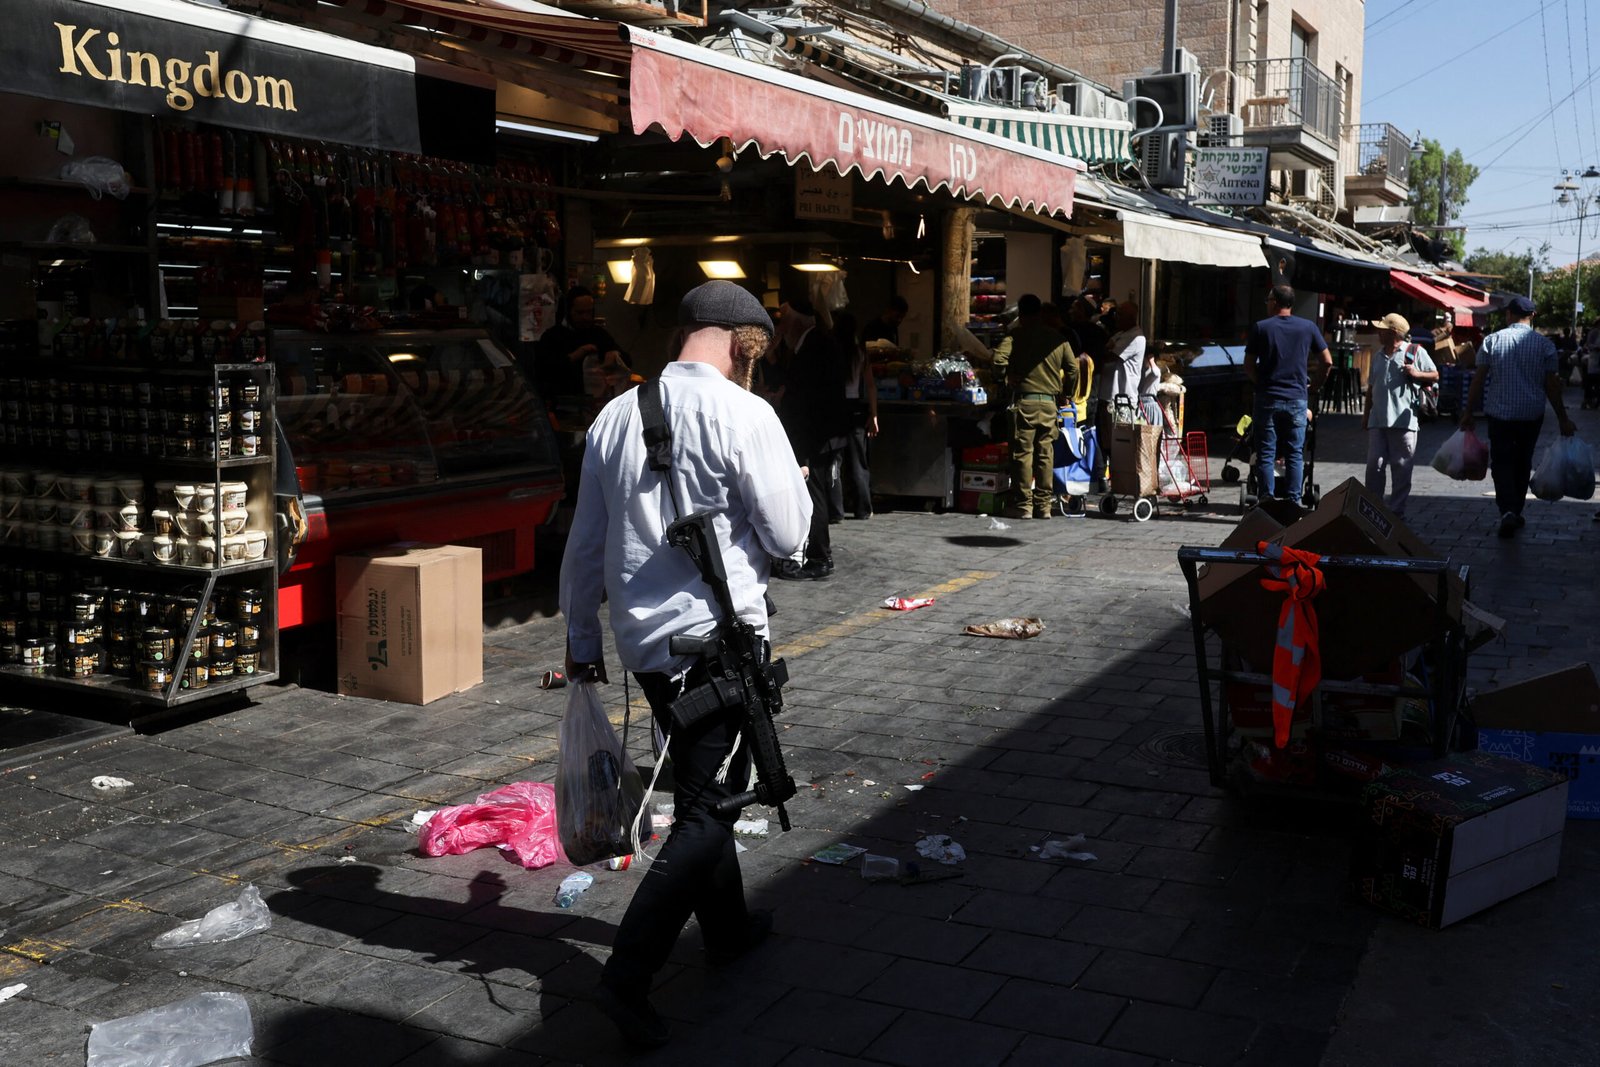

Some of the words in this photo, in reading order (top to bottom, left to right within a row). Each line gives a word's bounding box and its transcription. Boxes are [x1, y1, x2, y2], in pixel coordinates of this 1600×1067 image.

[53, 21, 298, 112] Kingdom
[838, 111, 913, 167] חמוצים
[1201, 152, 1240, 164] מרקחת
[1242, 152, 1263, 162] בית
[948, 142, 978, 189] כהן
[1219, 177, 1260, 188] Аптека
[1198, 191, 1257, 200] PHARMACY
